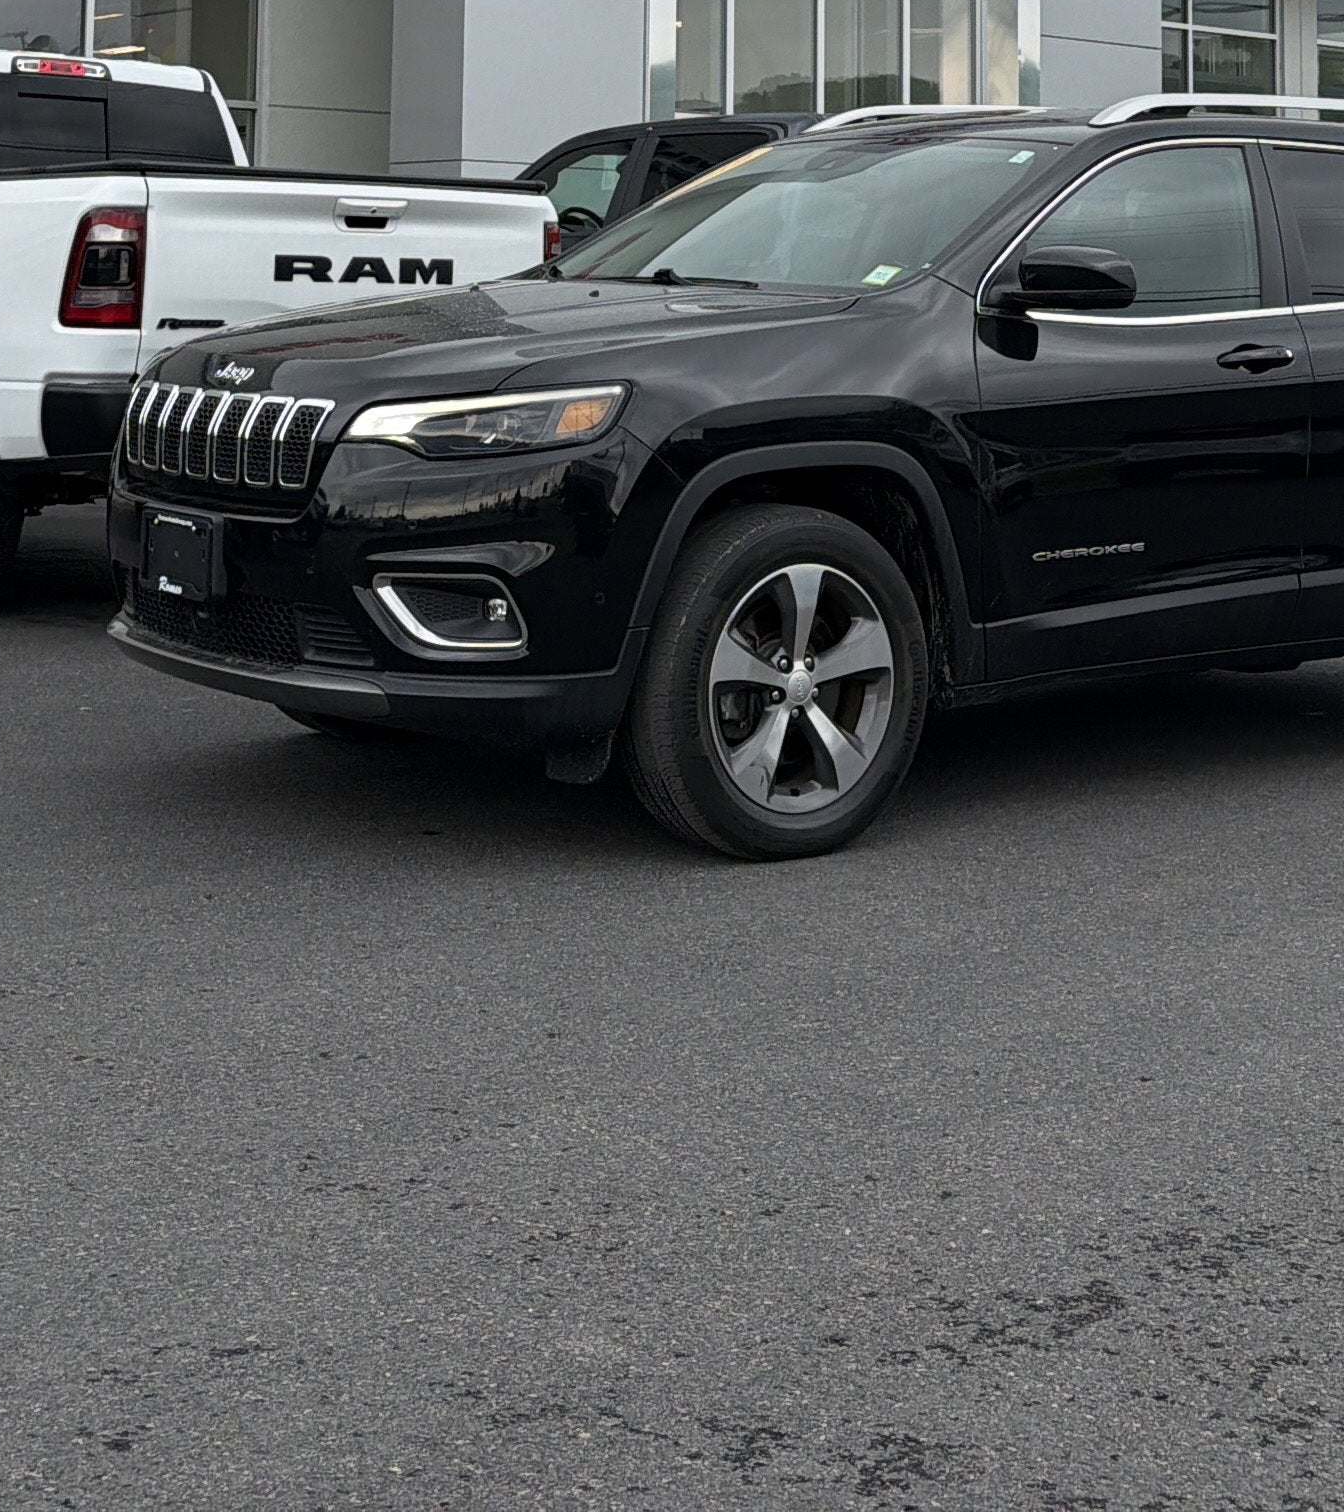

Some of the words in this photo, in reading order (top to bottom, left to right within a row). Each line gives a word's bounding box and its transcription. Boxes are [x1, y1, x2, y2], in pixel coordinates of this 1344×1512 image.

[273, 254, 454, 285] RAM
[214, 361, 255, 386] Jeep
[1032, 542, 1146, 562] CHEROKEE
